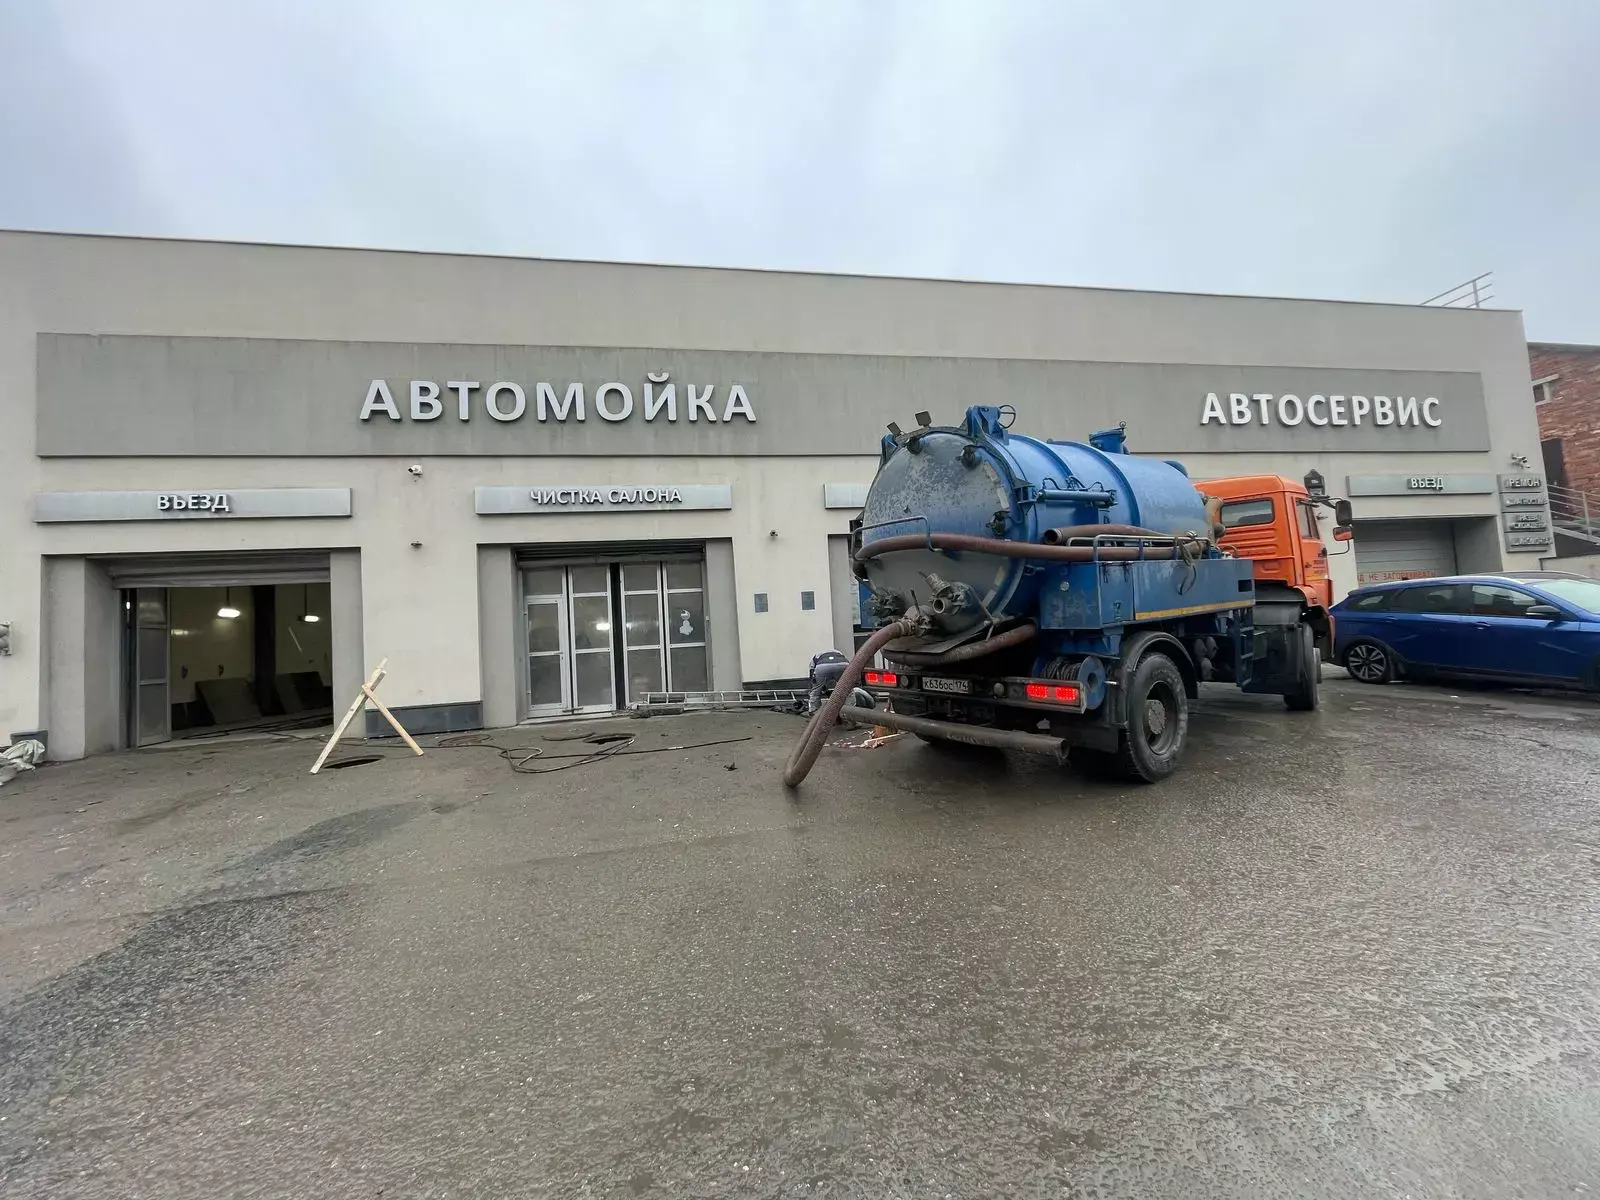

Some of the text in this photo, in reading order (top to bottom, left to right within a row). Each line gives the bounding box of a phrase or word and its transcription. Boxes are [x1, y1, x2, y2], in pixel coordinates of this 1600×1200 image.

[359, 371, 757, 422] АВТОМОЙКА
[1200, 392, 1442, 427] АВТОСЕРВИС
[157, 494, 231, 512] ВЪЕЗД
[529, 487, 683, 504] ЧИСТКА САЛОНА
